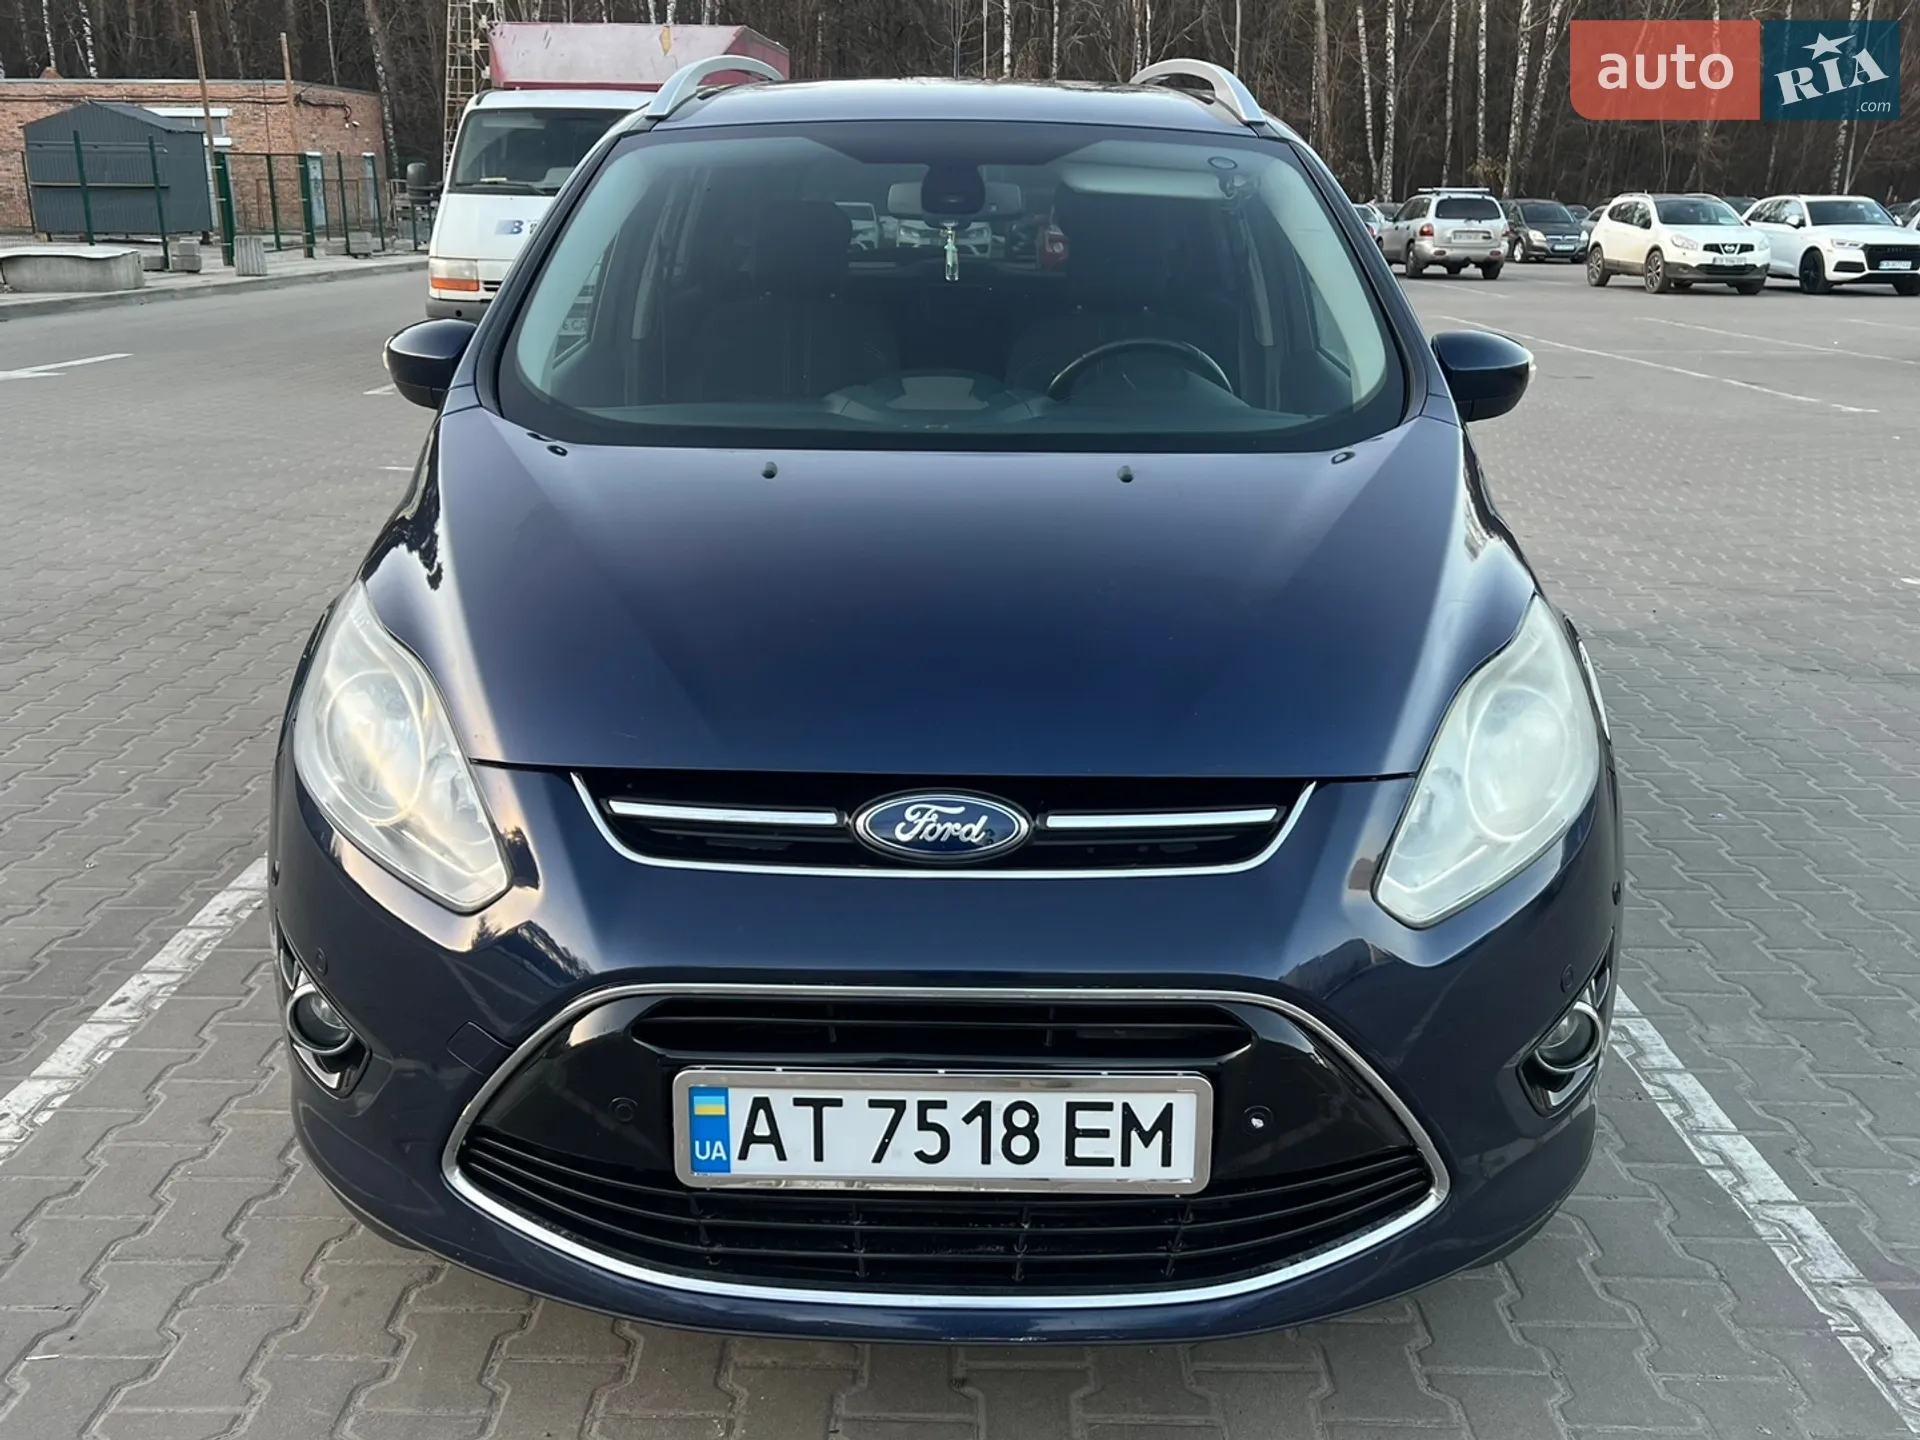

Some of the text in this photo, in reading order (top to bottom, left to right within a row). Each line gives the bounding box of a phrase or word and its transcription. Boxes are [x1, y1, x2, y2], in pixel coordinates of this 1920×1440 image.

[894, 803, 988, 843] Ford
[694, 1140, 728, 1161] UA
[737, 1096, 1174, 1168] AT 7518 EM
